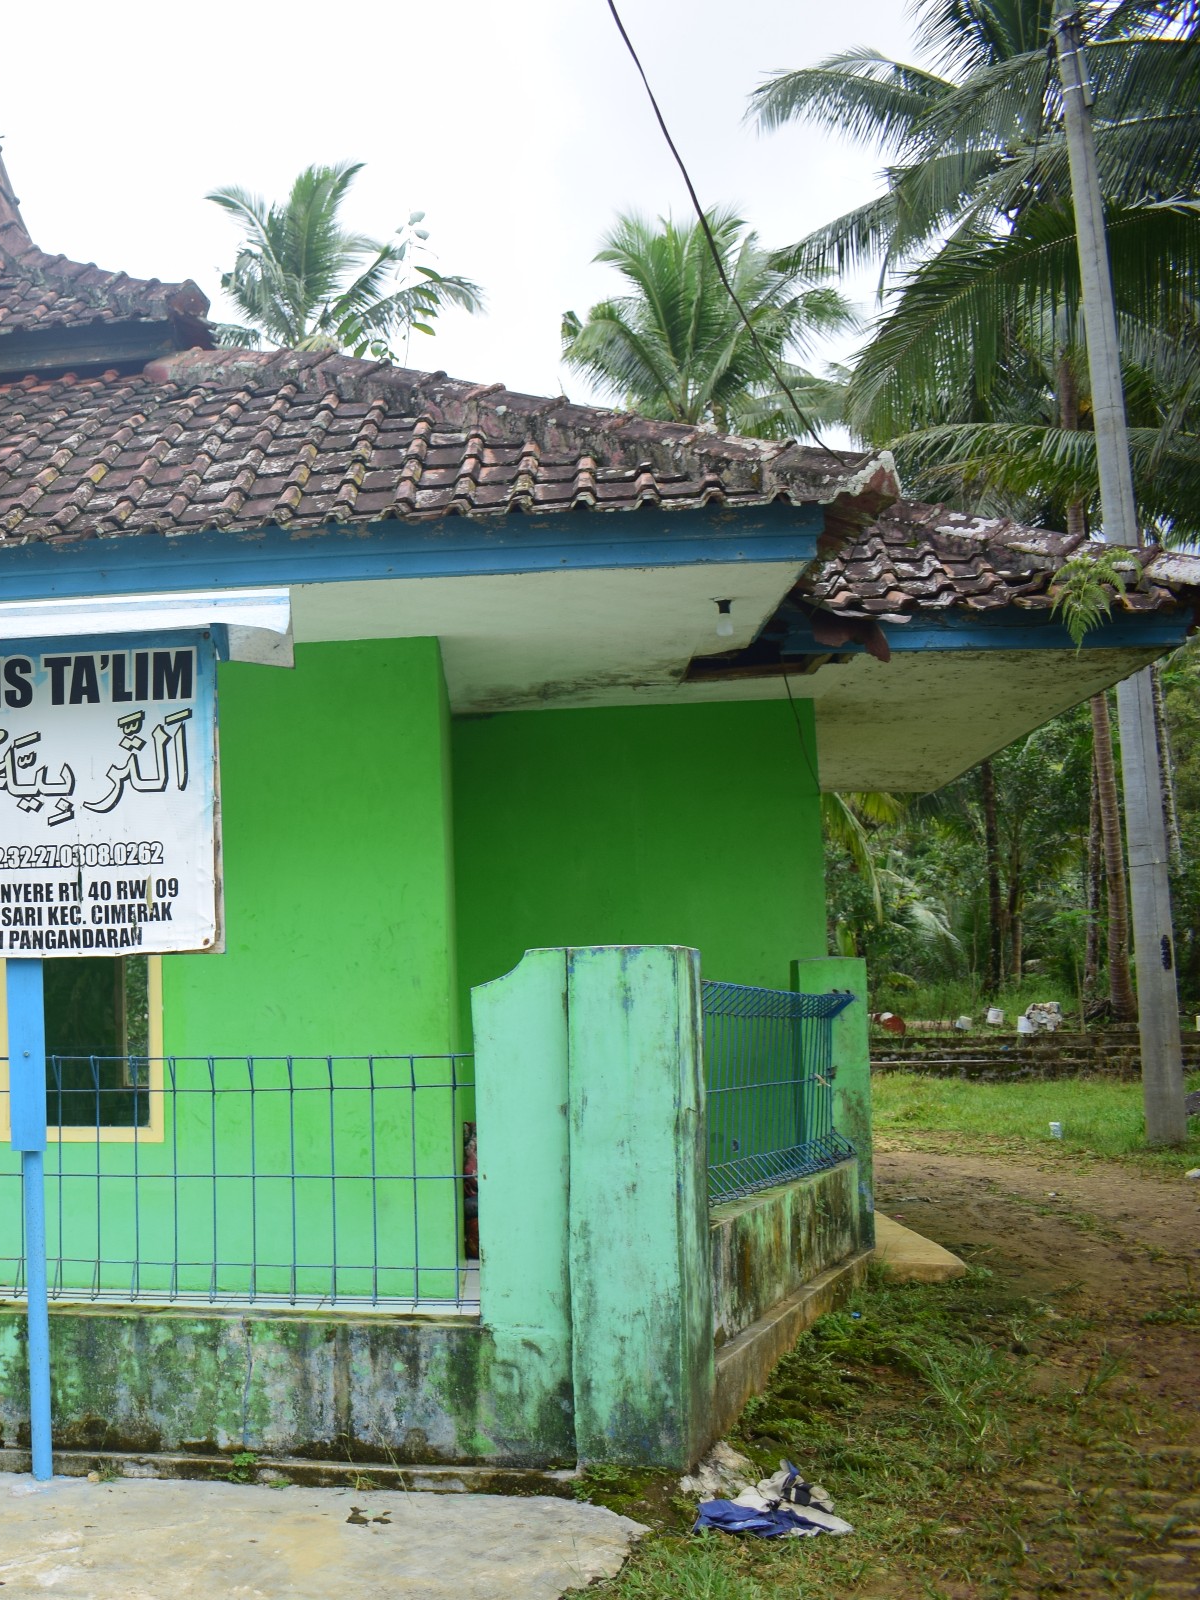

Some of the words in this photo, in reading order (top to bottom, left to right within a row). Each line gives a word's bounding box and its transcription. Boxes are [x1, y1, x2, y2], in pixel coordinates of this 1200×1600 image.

[43, 650, 193, 706] TA'LIM
[58, 882, 78, 903] RT
[88, 881, 112, 901] 40
[116, 879, 147, 901] RW
[155, 877, 179, 899] 09
[47, 905, 87, 927] KEC.
[91, 901, 173, 925] CIMERAK
[9, 927, 143, 950] PANGANDARAN
